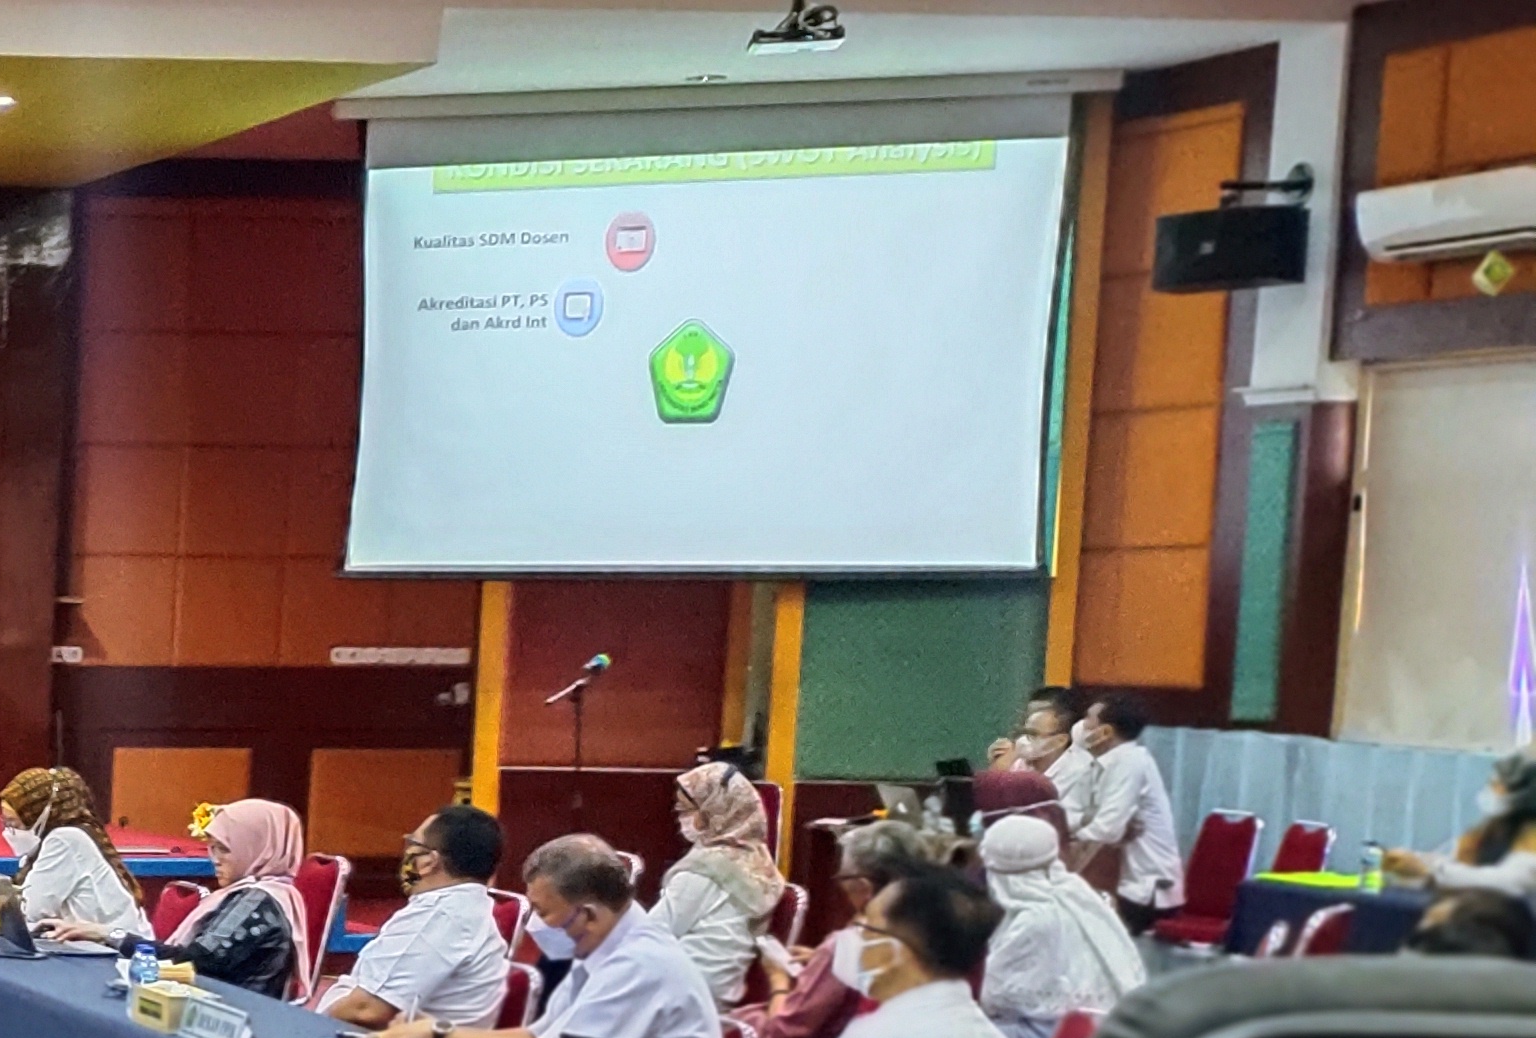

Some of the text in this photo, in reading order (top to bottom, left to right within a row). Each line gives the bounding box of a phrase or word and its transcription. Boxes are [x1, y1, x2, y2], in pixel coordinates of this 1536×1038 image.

[413, 231, 569, 249] Kualitas SDM Dosen
[417, 293, 548, 311] Akreditasi PT, PS
[450, 315, 547, 331] dan Akrd Int
